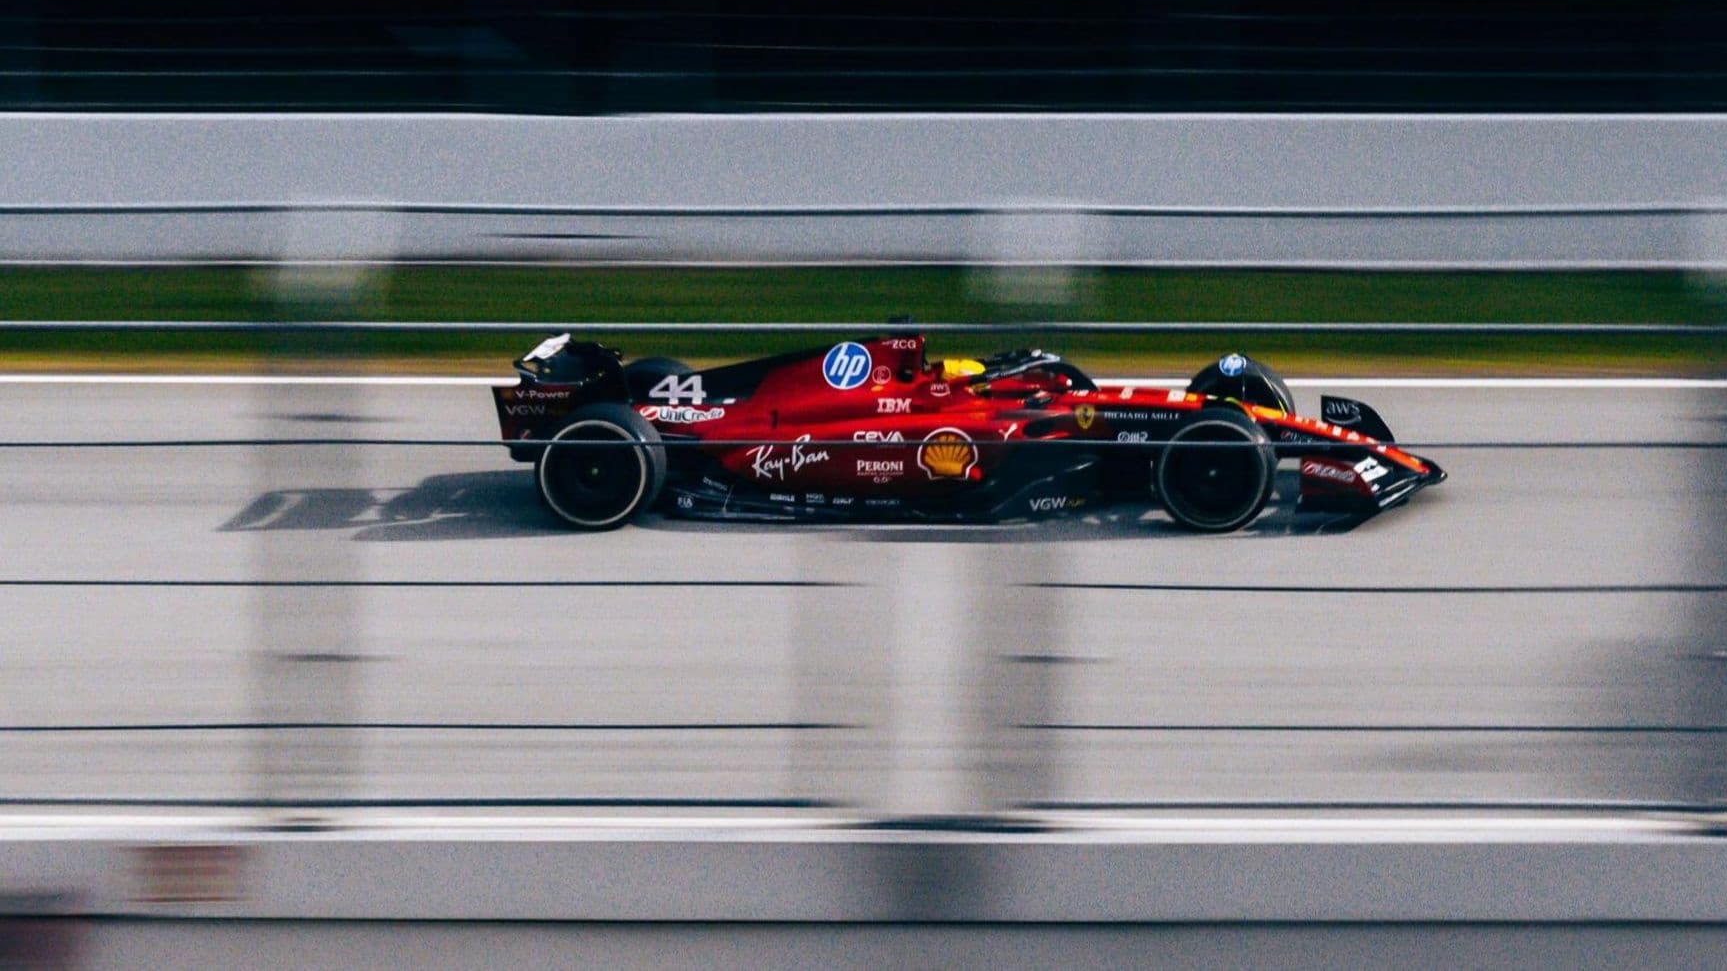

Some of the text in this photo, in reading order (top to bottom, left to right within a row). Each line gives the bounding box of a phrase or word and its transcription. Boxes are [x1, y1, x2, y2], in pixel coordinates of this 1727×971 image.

[830, 342, 866, 389] hp
[516, 390, 570, 399] V-Power
[649, 375, 707, 405] 44
[505, 405, 545, 416] VGW
[877, 398, 912, 413] IBM
[746, 435, 830, 480] Ray-Ban
[857, 460, 904, 471] PERONI
[1029, 496, 1066, 511] VGW
